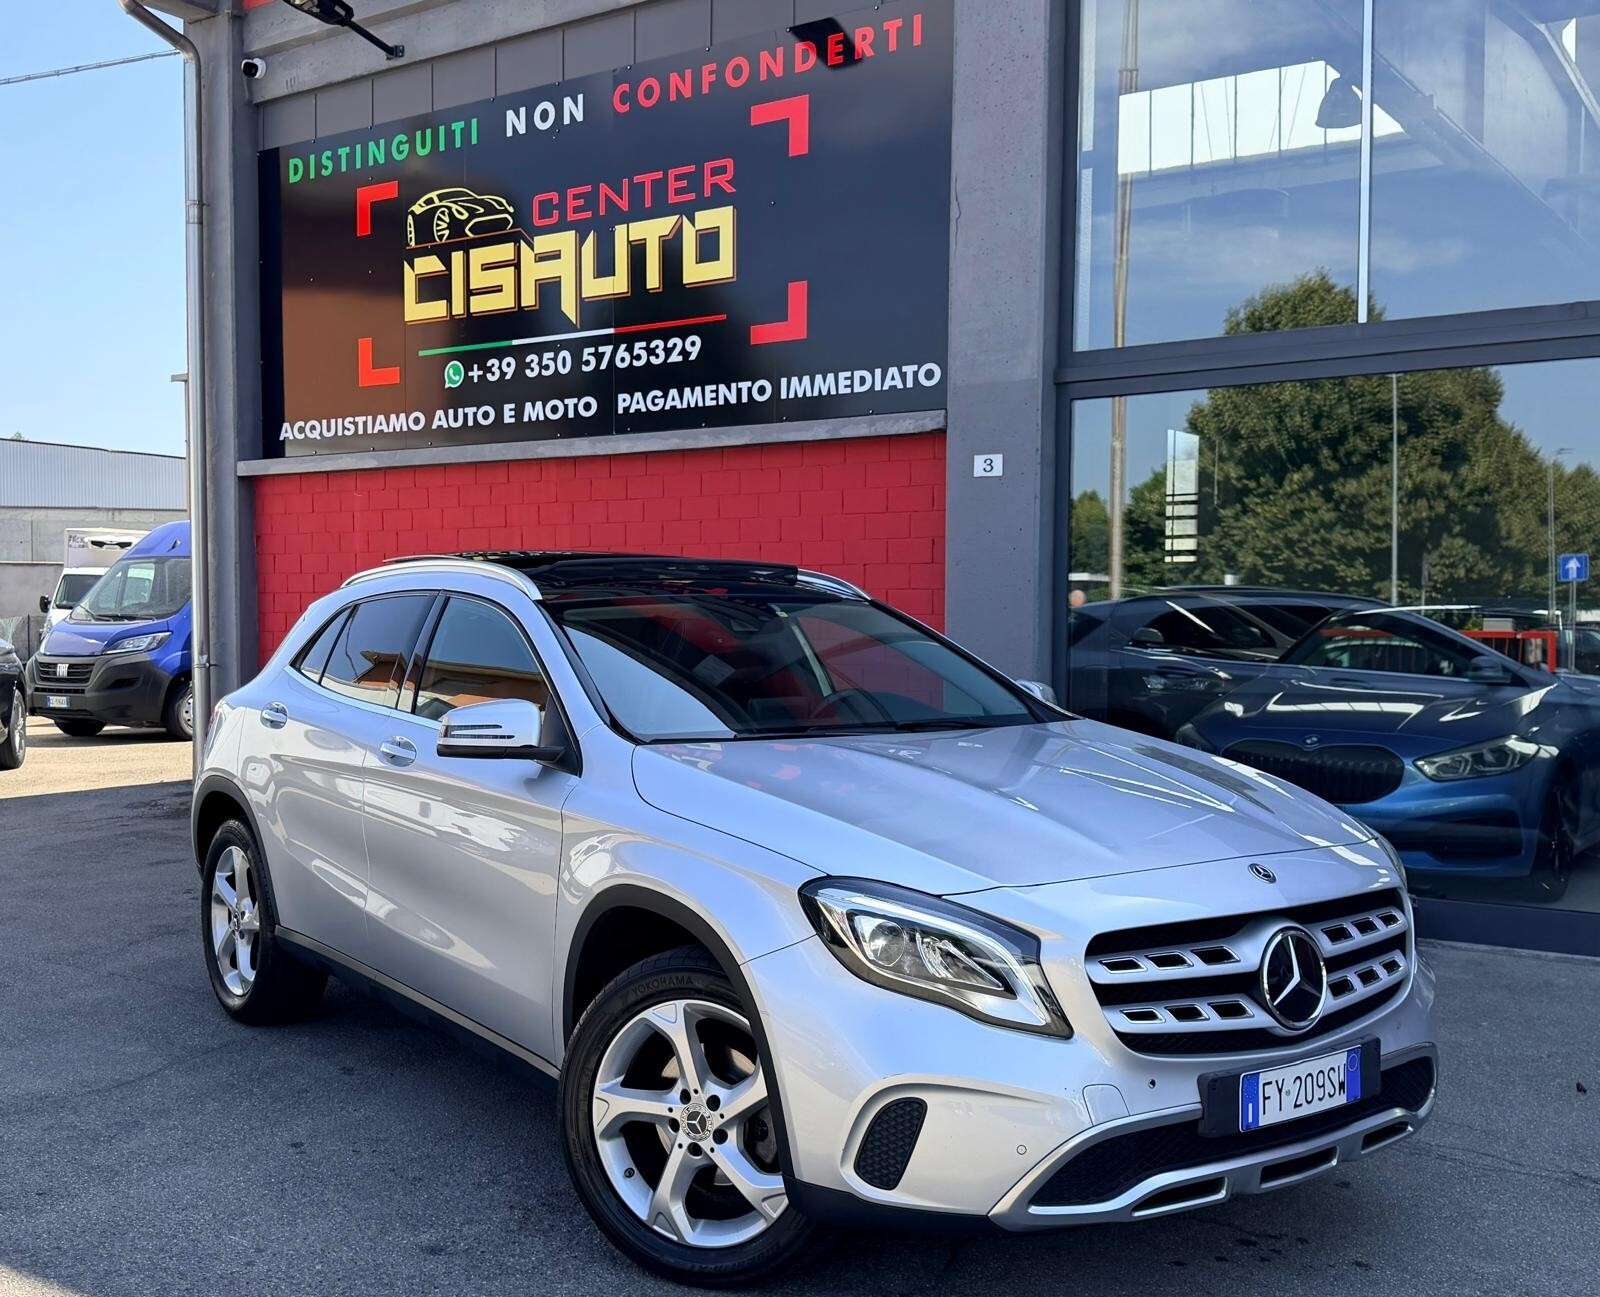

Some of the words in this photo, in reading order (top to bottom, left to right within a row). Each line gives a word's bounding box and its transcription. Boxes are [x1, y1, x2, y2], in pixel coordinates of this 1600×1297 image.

[289, 117, 478, 183] DISTINGUITI
[505, 93, 584, 137] NON
[613, 14, 922, 113] CONFONDERTI
[532, 158, 737, 227] CENTER
[404, 205, 737, 328] CISAUTO
[468, 356, 516, 383] +39
[525, 350, 571, 378] 350
[582, 335, 702, 373] 5765329
[279, 411, 426, 441] ACQUISTIAMO
[431, 405, 495, 430] AUTO
[503, 403, 516, 424] E
[523, 396, 598, 422] MOTO
[617, 379, 773, 415] PAGAMENTO
[780, 362, 942, 400] IMMEDIATO
[983, 457, 994, 473] 3
[631, 975, 694, 995] YOKOHAMA
